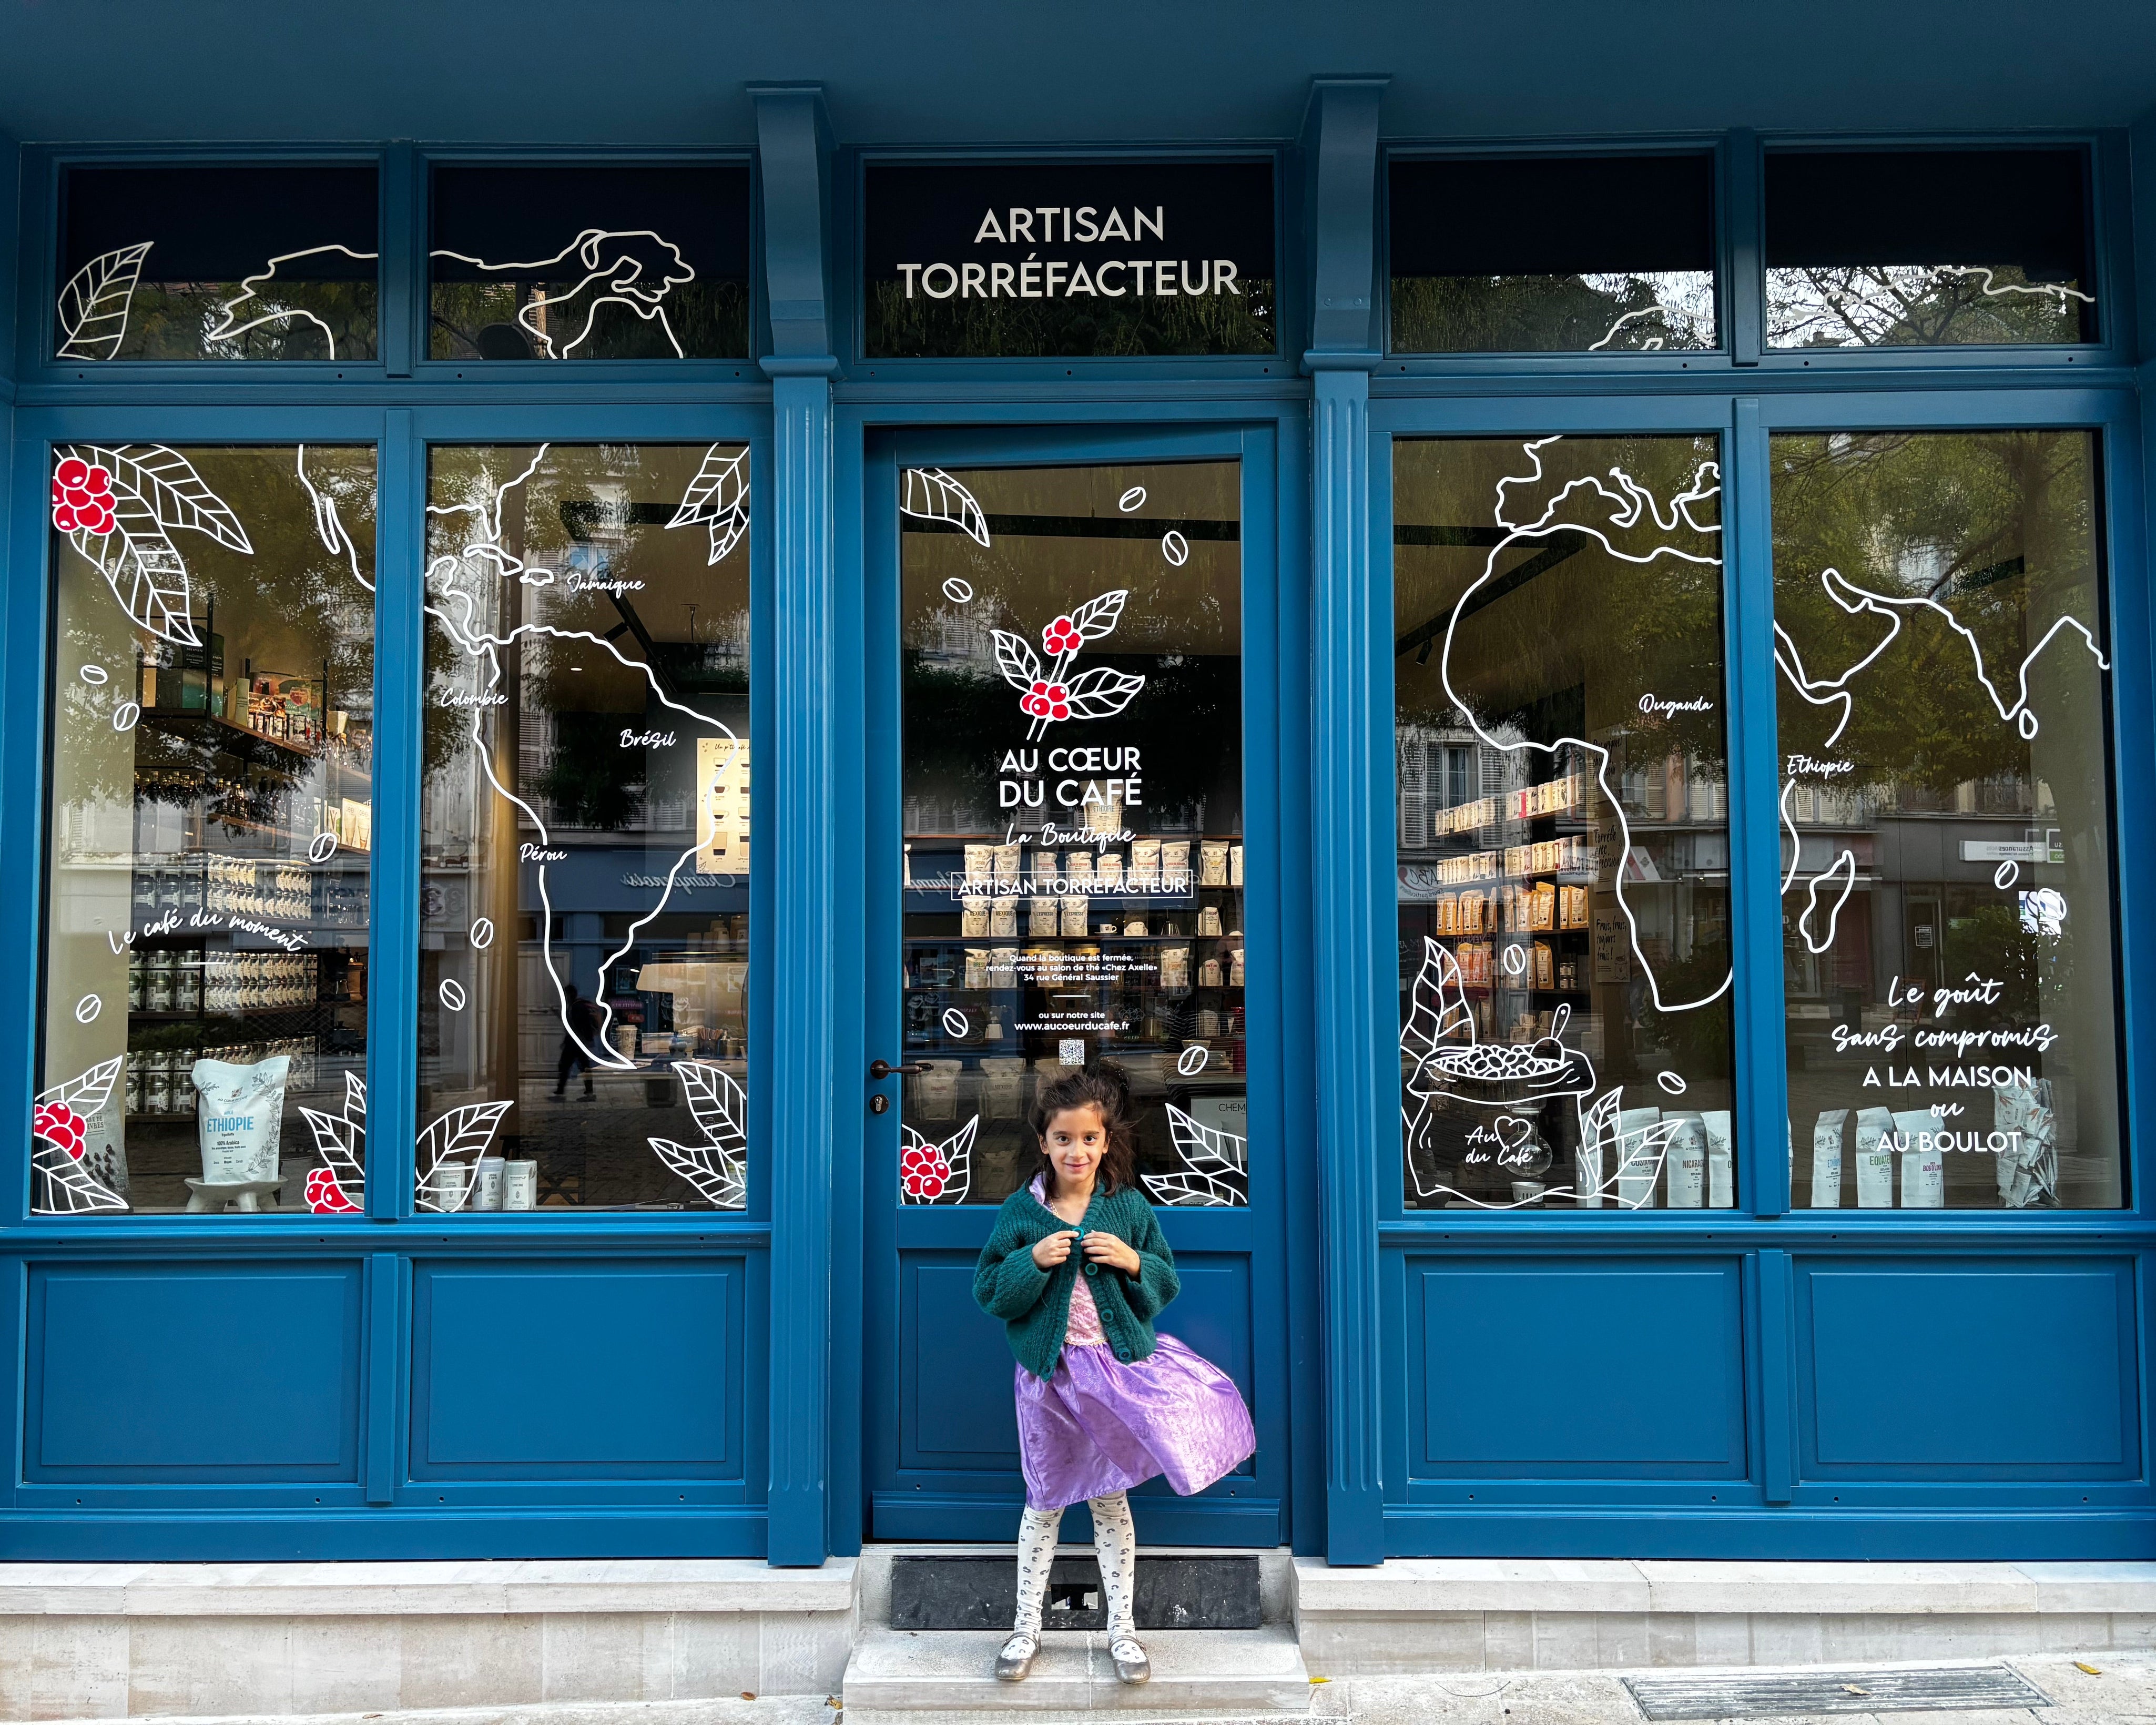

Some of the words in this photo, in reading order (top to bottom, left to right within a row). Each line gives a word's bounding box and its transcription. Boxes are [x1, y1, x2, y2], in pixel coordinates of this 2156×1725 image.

[974, 206, 1164, 242] ARTISAN
[897, 252, 1240, 298] TORRÉFACTEUR
[567, 573, 646, 599] Jamaique
[440, 689, 509, 707] Colombie
[1639, 693, 1714, 719] Ouganda
[619, 728, 677, 749] Brésil
[999, 748, 1039, 772] AU
[1048, 746, 1142, 772] CŒUR
[1787, 755, 1854, 780] Ethiopie
[1000, 779, 1044, 807] DU
[1056, 772, 1142, 807] CAFÉ
[1005, 823, 1032, 847] La
[1040, 821, 1137, 854] Boutique
[520, 841, 567, 863] Pérou
[958, 877, 1038, 896] ARTISAN
[1042, 876, 1187, 895] TORREFACTEUR
[108, 930, 136, 955] Le
[144, 908, 184, 937] café
[190, 907, 223, 927] du
[229, 914, 309, 952] moment
[1596, 919, 1611, 932] Frais,
[1612, 915, 1626, 932] frais,
[1597, 933, 1615, 950] toujours
[1049, 955, 1086, 963] boutique
[1102, 954, 1133, 962] fermée,
[1887, 976, 1925, 1007] Le
[1933, 971, 2005, 1018] goût
[1014, 1021, 1130, 1031] www.aucoeurducafe.fr
[1914, 1023, 2059, 1059] compromis
[1862, 1066, 1882, 1087] A
[1889, 1066, 1921, 1087] LA
[1929, 1066, 2032, 1087] MAISON
[1929, 1102, 1965, 1118] ou
[207, 1116, 254, 1133] ETHIOPIE
[1465, 1125, 1499, 1145] Au
[1876, 1131, 1910, 1152] AU
[1919, 1131, 2022, 1152] BOULOT
[1465, 1148, 1491, 1164] du
[1497, 1145, 1533, 1166] Café
